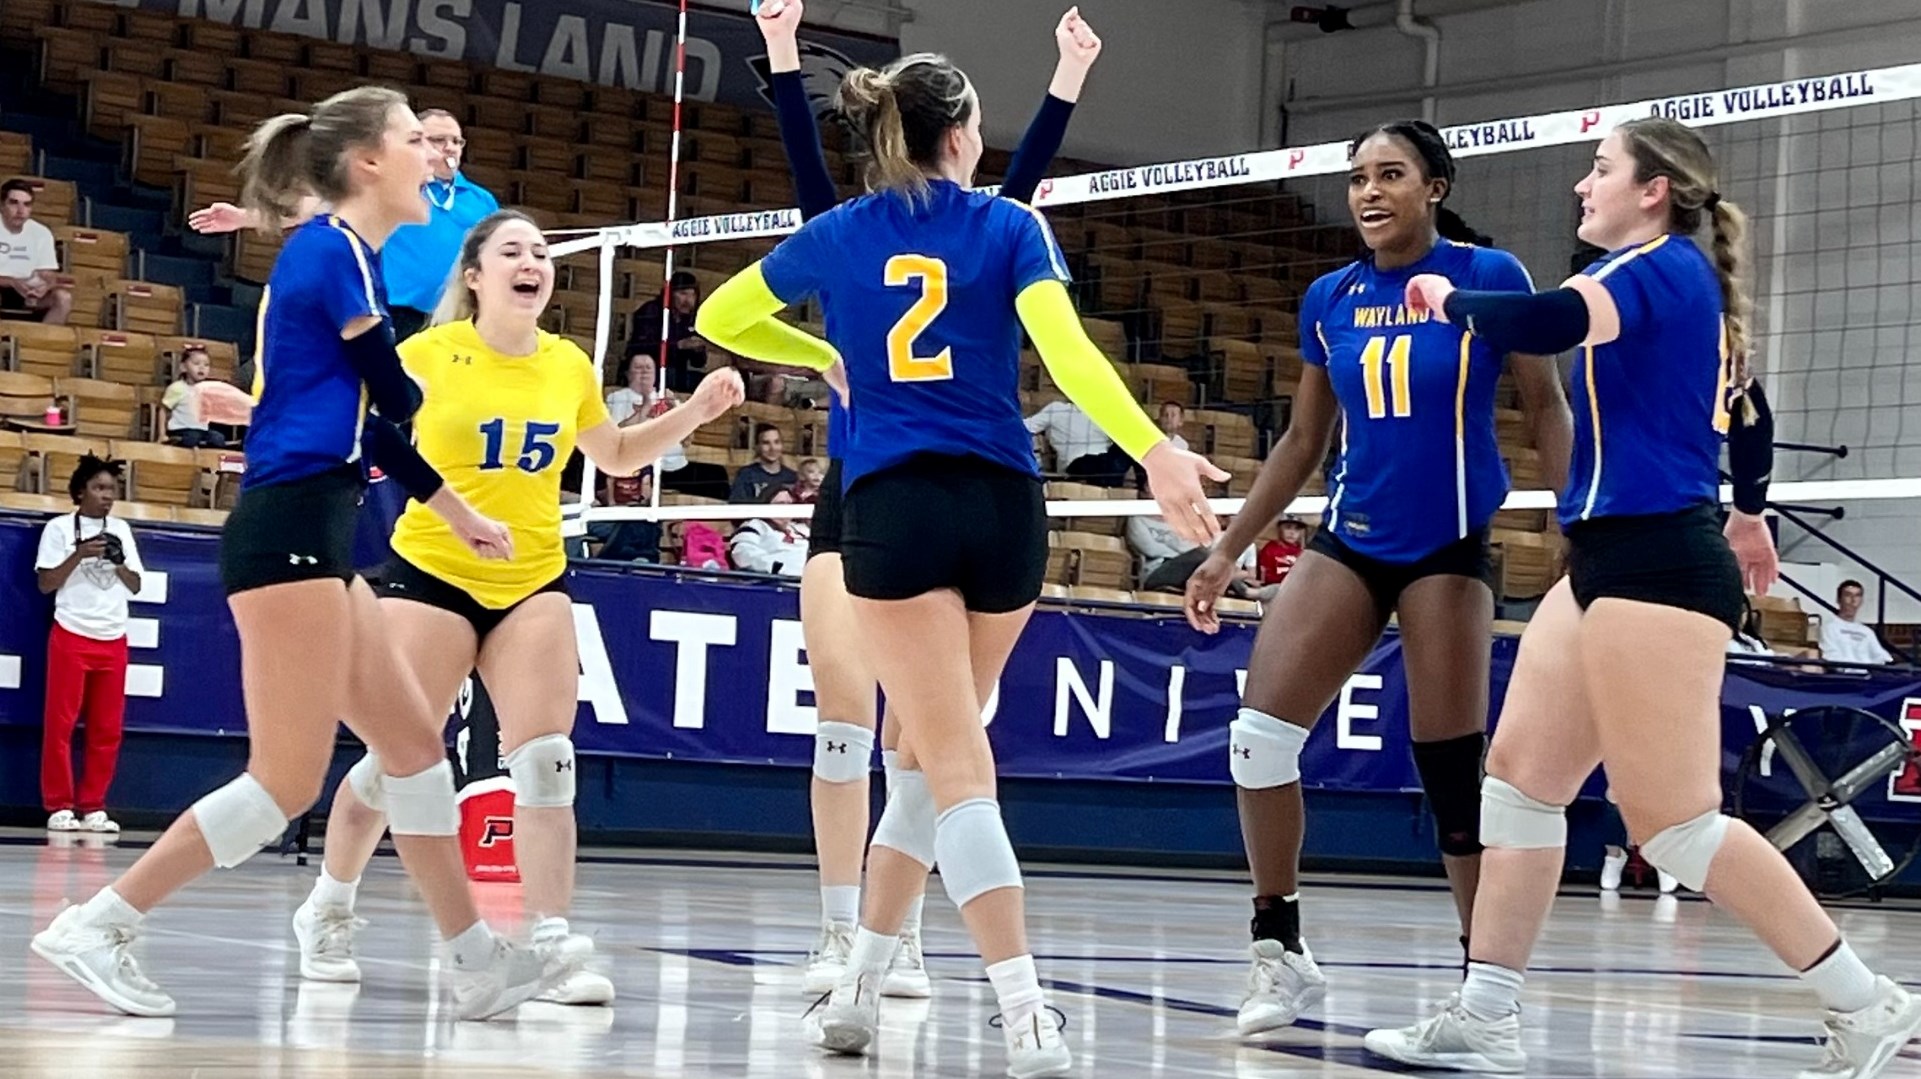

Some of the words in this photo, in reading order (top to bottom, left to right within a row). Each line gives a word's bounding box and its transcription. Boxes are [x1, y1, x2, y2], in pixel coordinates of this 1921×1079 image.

[496, 2, 721, 103] LAND
[1651, 96, 1714, 120] AGGIE
[1723, 73, 1874, 115] VOLLEYBALL
[1446, 120, 1535, 150] LEYBALL
[1089, 170, 1137, 194] AGGIE
[1141, 157, 1251, 187] VOLLEYBALL
[672, 218, 710, 239] AGGIE
[714, 210, 796, 234] VOLLEYBALL
[884, 254, 954, 383] 2
[1359, 334, 1412, 419] 11
[478, 418, 561, 473] 15
